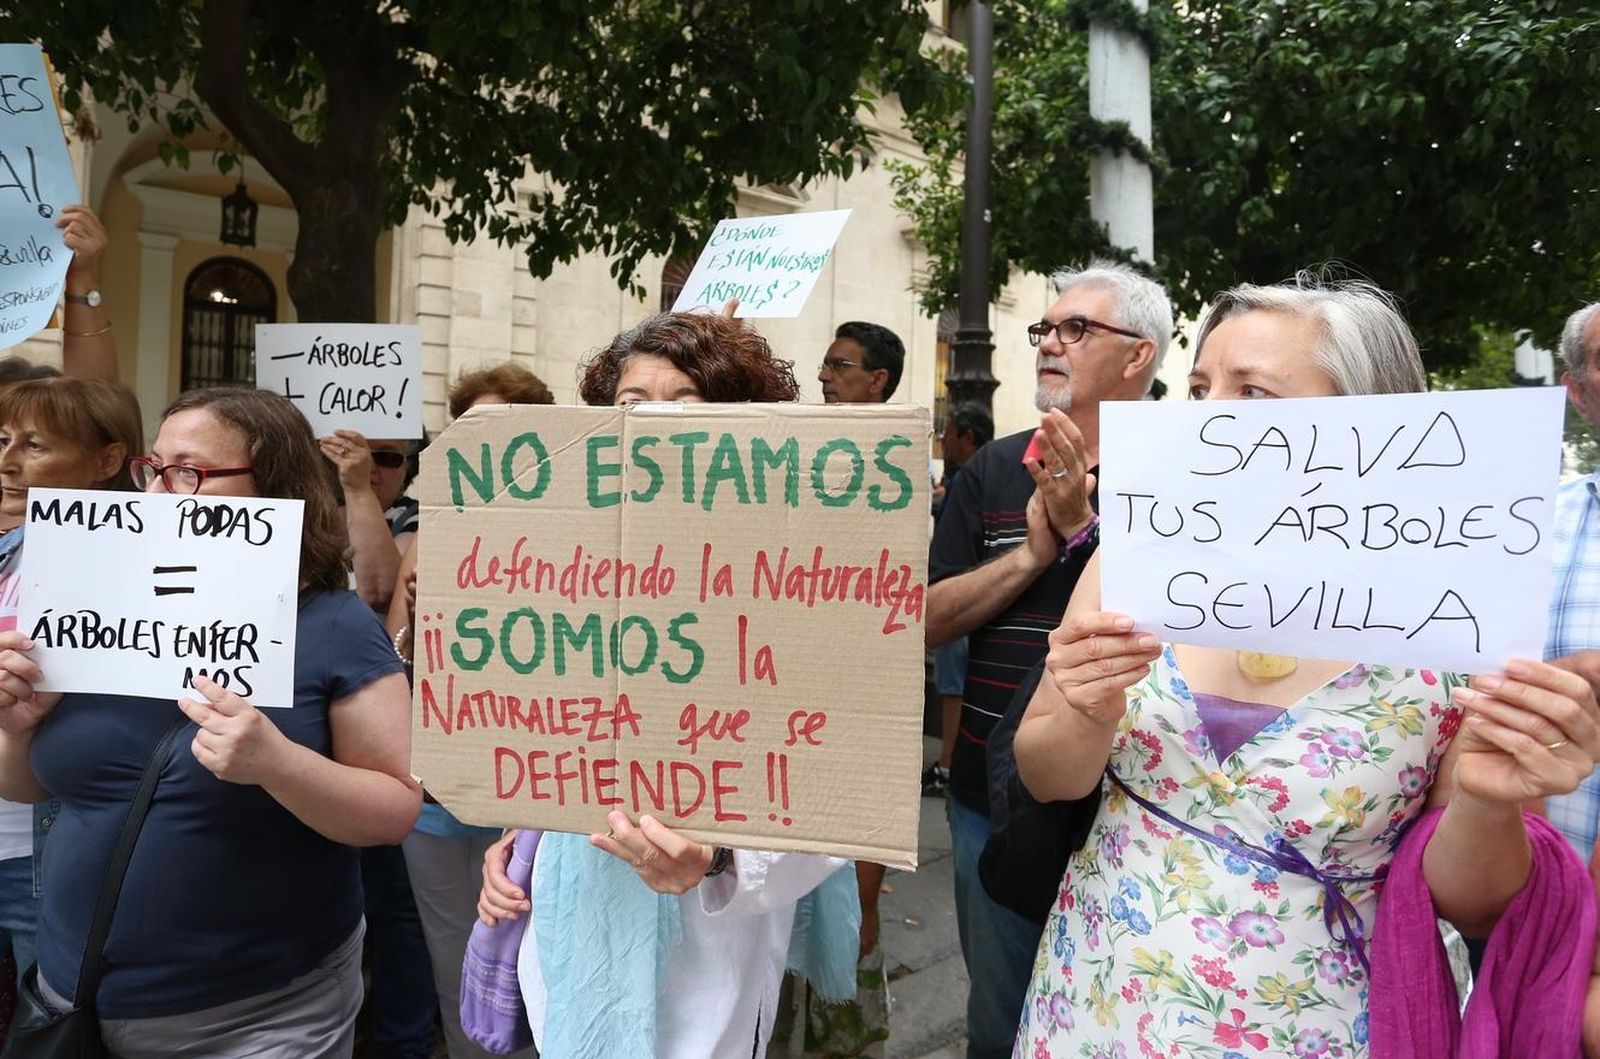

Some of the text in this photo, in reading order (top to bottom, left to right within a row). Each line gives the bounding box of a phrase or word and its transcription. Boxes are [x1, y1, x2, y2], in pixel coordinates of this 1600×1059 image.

[446, 431, 914, 512] NO ESTAMOS
[1190, 411, 1466, 477] SALVA
[30, 498, 275, 546] MALAS PODAS
[1116, 482, 1545, 555] TUS ÁRBOLES
[457, 536, 923, 634] defendiendo la Naturaleza
[1164, 571, 1481, 653] SEVILLA
[31, 609, 165, 658] ÁRBOLES
[738, 615, 777, 685] la
[678, 703, 752, 752] que
[784, 710, 827, 746] se
